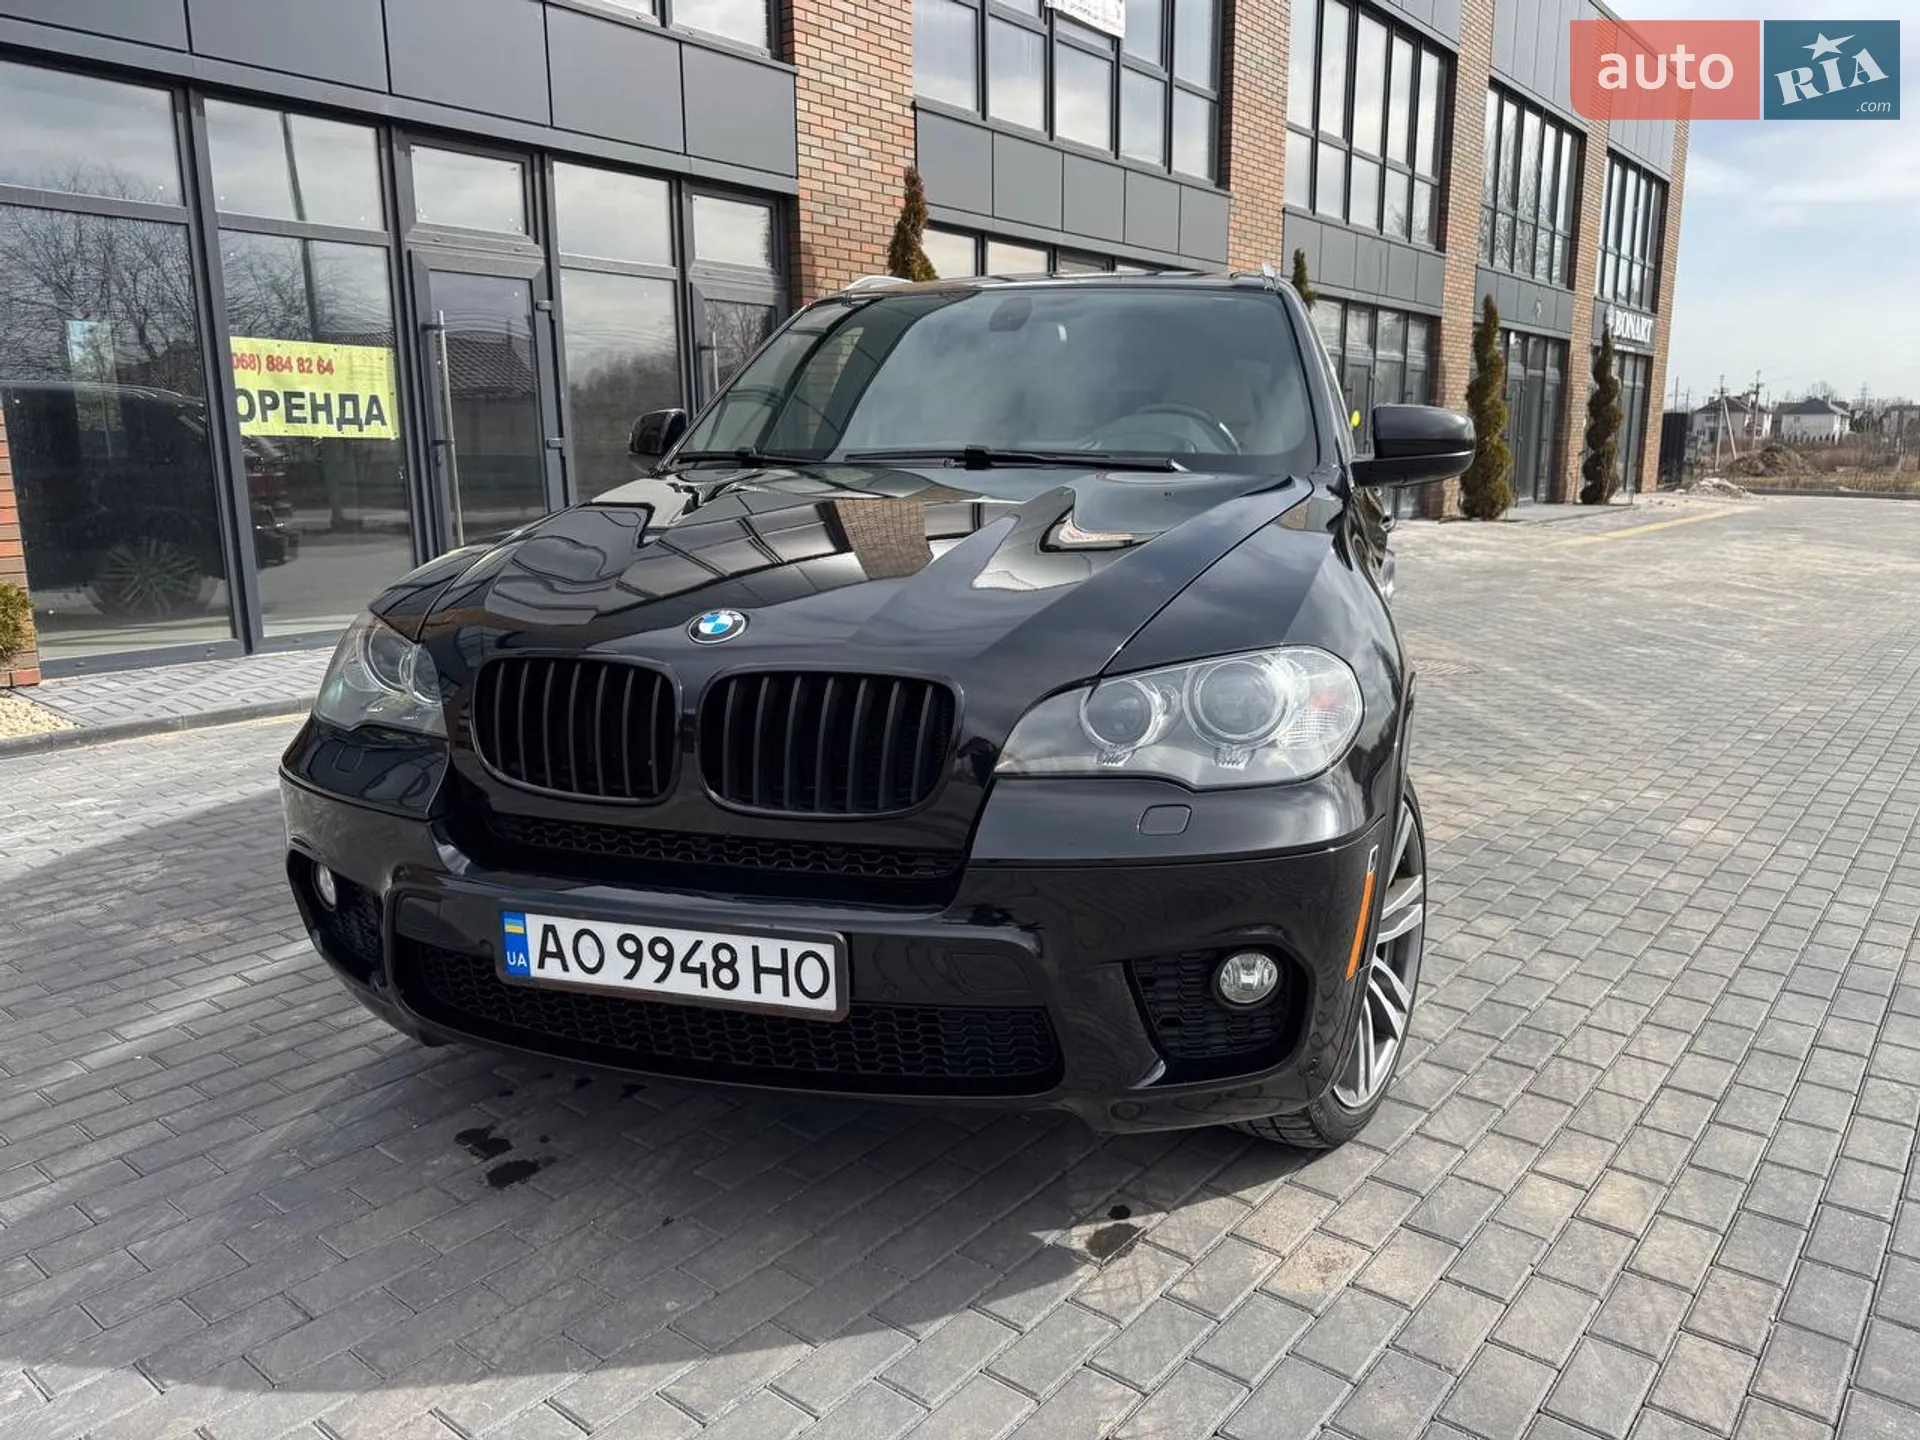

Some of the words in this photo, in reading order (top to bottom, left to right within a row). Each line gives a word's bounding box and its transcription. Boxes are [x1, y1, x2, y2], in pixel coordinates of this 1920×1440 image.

[266, 355, 293, 373] 884
[296, 357, 313, 374] 82
[316, 358, 335, 375] 64
[235, 388, 388, 432] ОРЕНДА
[507, 951, 528, 968] UA
[537, 923, 605, 975] AO
[616, 932, 740, 991] 9948
[751, 945, 830, 1000] HO
